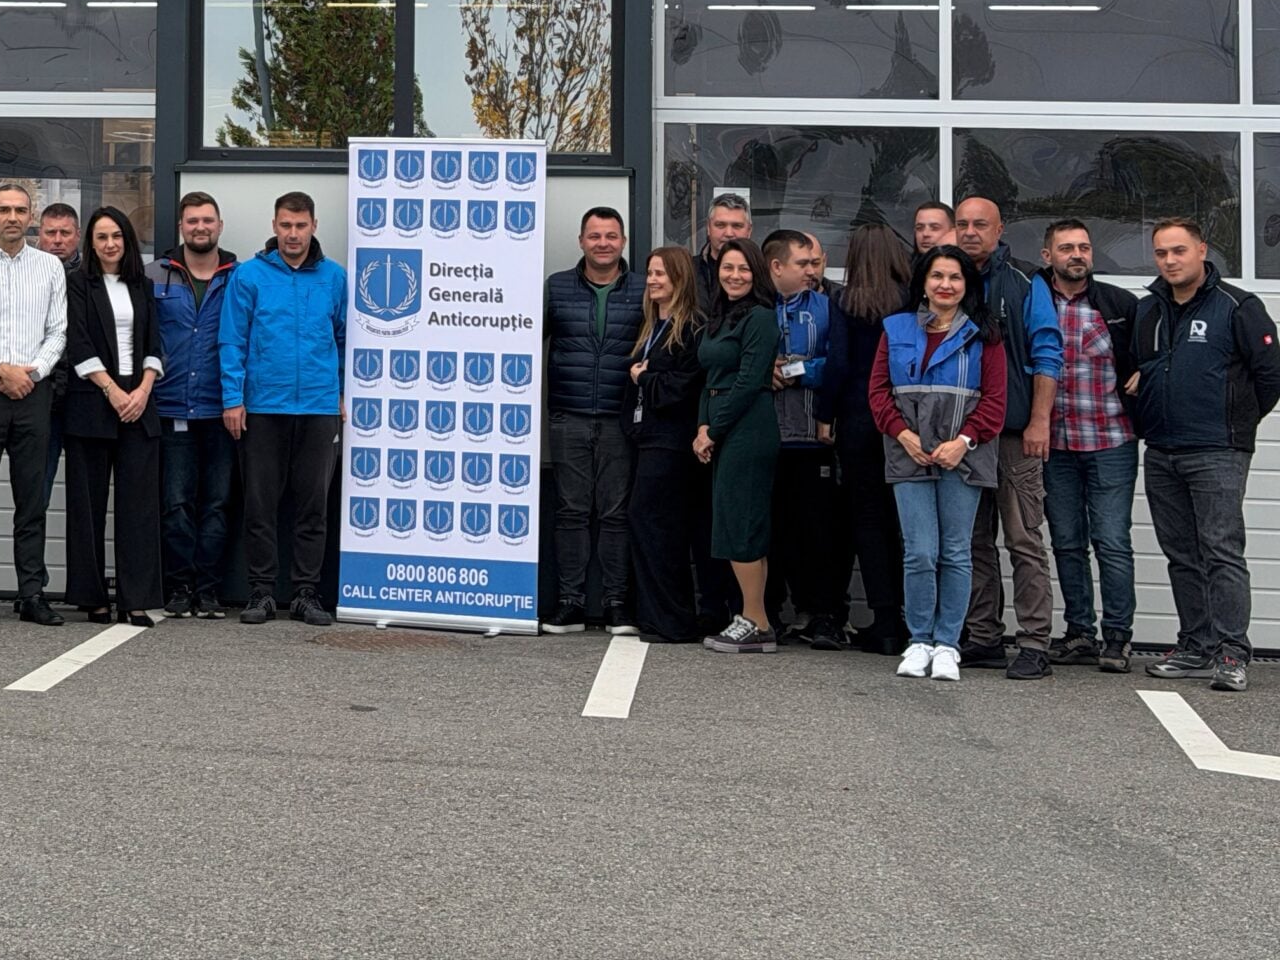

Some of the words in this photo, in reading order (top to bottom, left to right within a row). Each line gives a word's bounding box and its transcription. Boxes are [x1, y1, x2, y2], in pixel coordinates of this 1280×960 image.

[429, 262, 494, 282] Direcția
[428, 286, 504, 304] Generală
[427, 311, 534, 332] Anticorupție
[386, 563, 426, 582] 0800
[427, 566, 457, 585] 806
[458, 567, 489, 587] 806
[342, 584, 377, 600] CALL
[379, 586, 433, 603] CENTER
